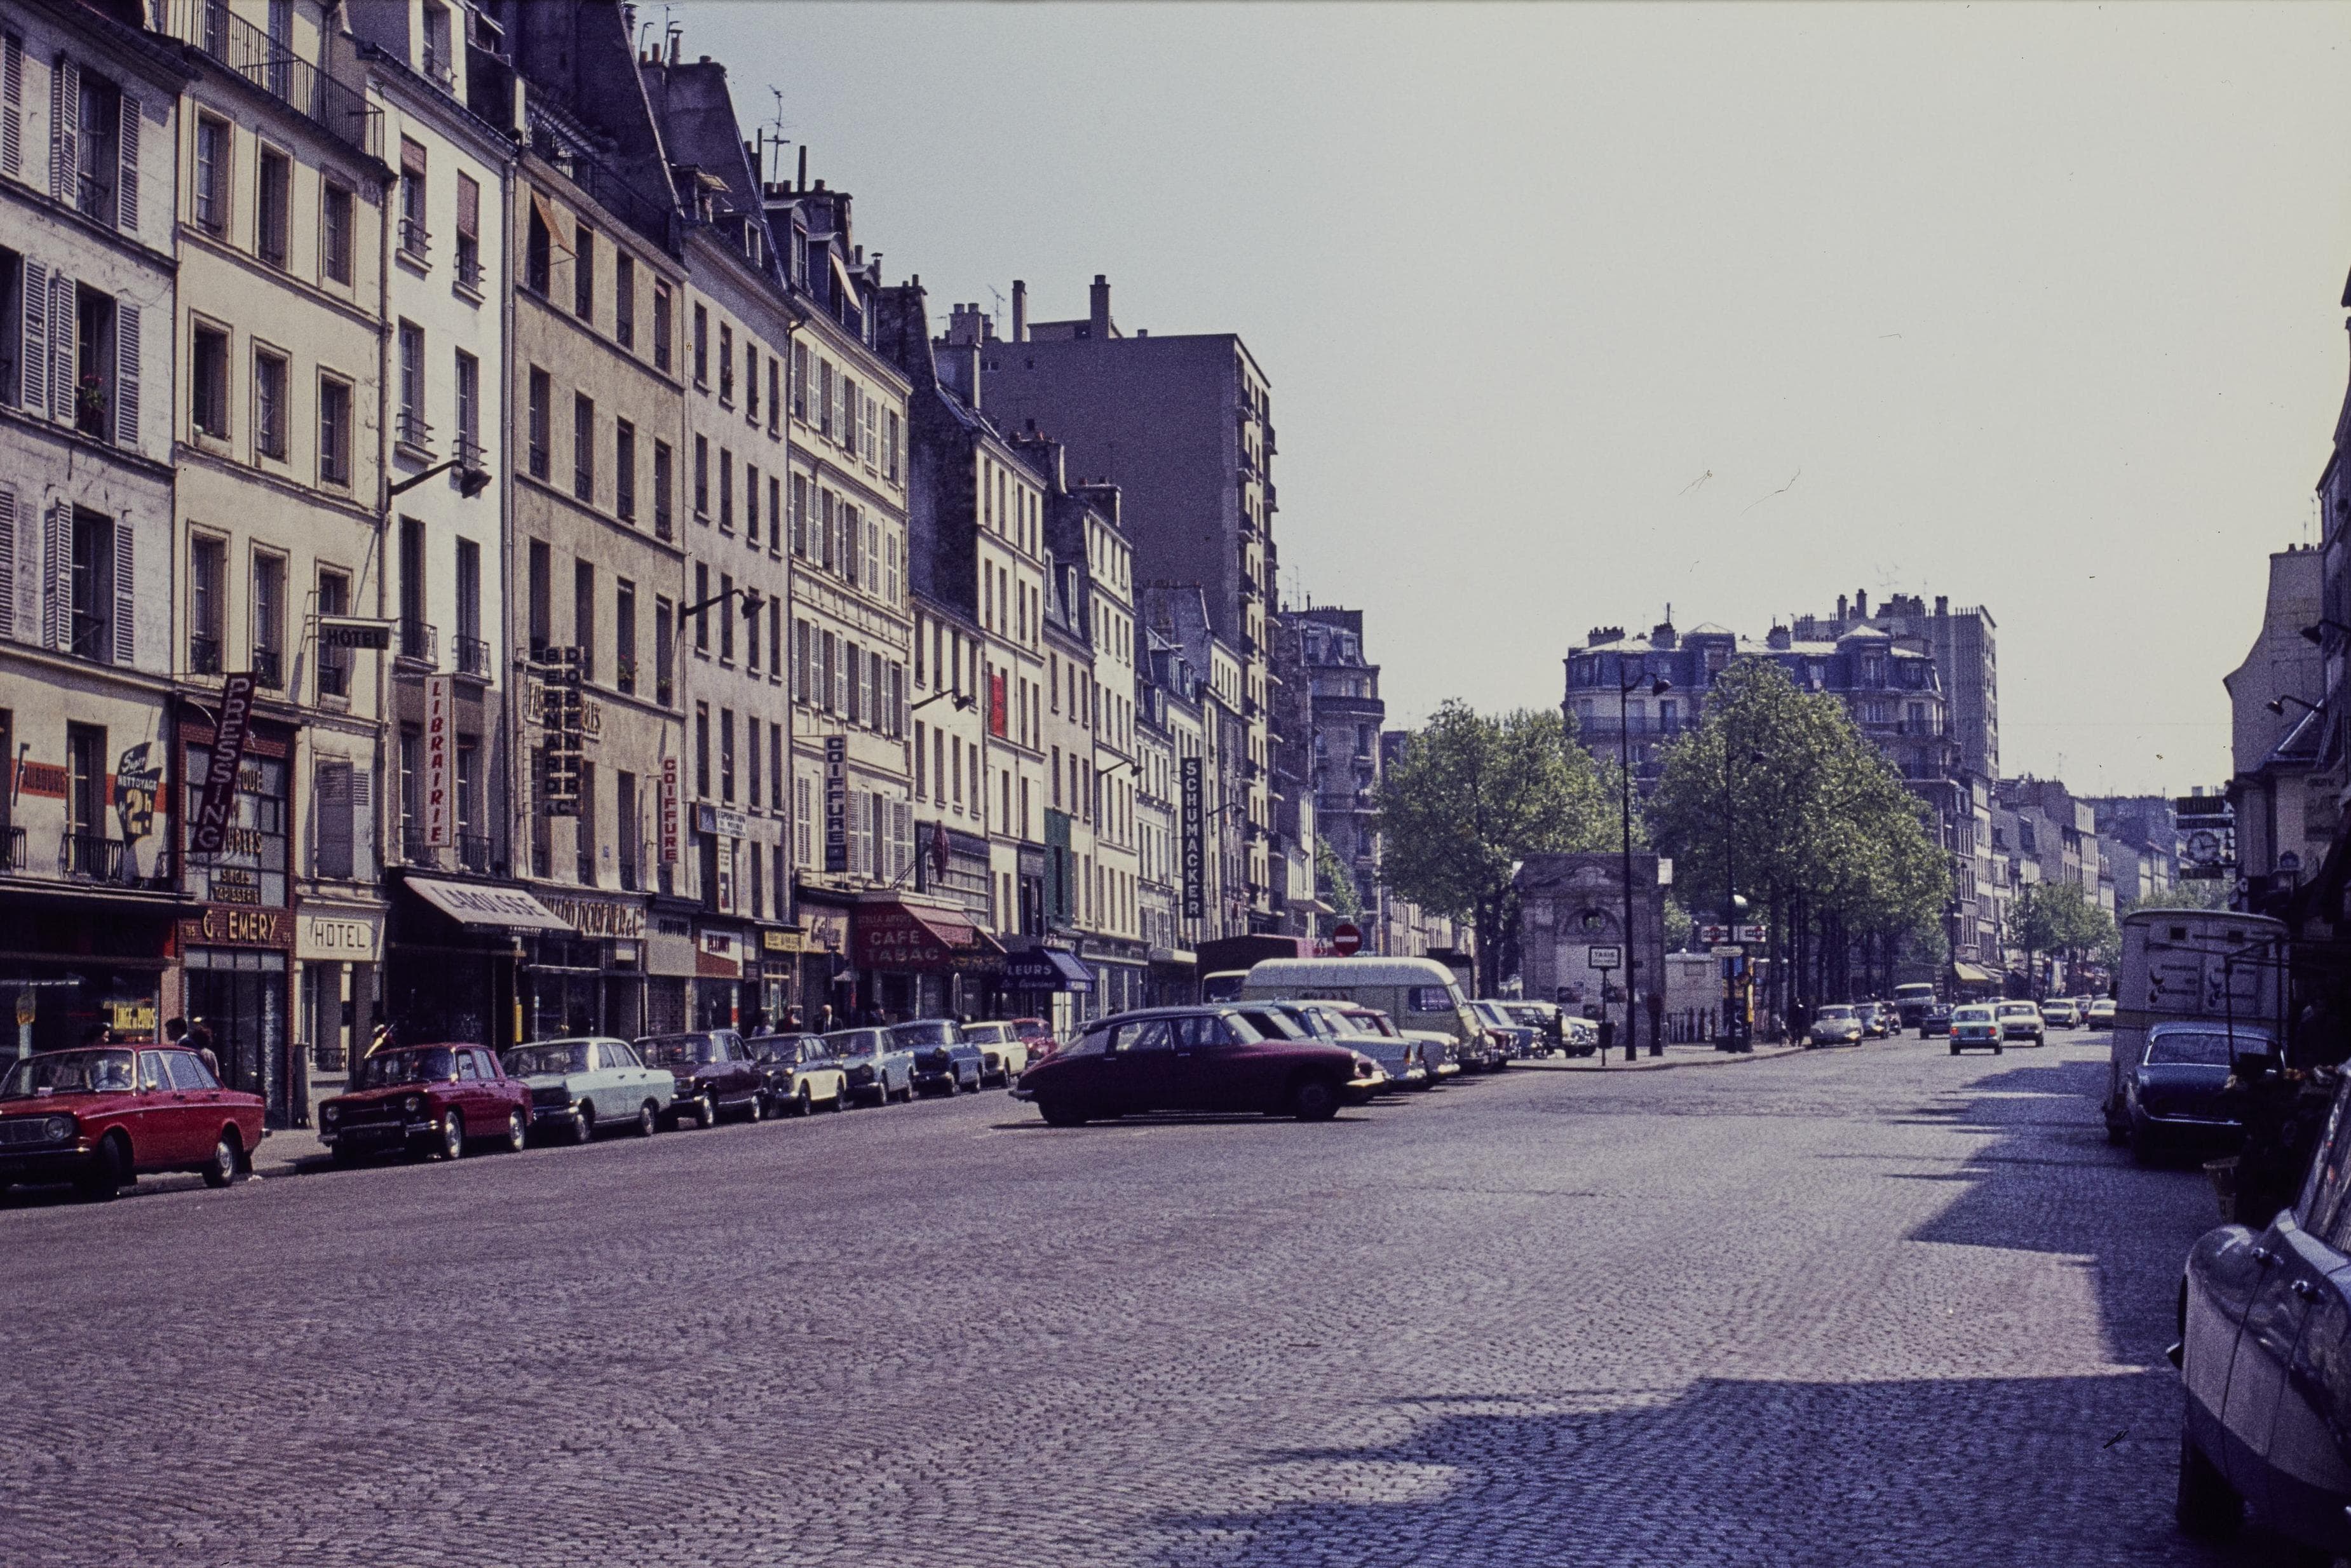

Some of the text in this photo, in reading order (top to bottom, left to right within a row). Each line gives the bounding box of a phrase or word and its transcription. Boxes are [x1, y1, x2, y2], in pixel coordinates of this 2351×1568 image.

[326, 628, 385, 649] HOTEL
[545, 648, 559, 792] BERNARD
[566, 648, 579, 792] DORFNER
[118, 774, 158, 791] NETTOYAGE
[197, 677, 251, 849] PRESSING
[430, 681, 444, 842] LIBRAIRIE
[827, 737, 844, 844] COIFFURE
[663, 759, 676, 860] COIFFURE
[1185, 762, 1200, 915] SCHUMACKER
[229, 912, 278, 942] EMERY
[431, 886, 546, 917] LAROUSSE
[315, 923, 365, 948] HOTEL
[865, 947, 939, 962] TABAC
[1004, 964, 1052, 976] LEURS
